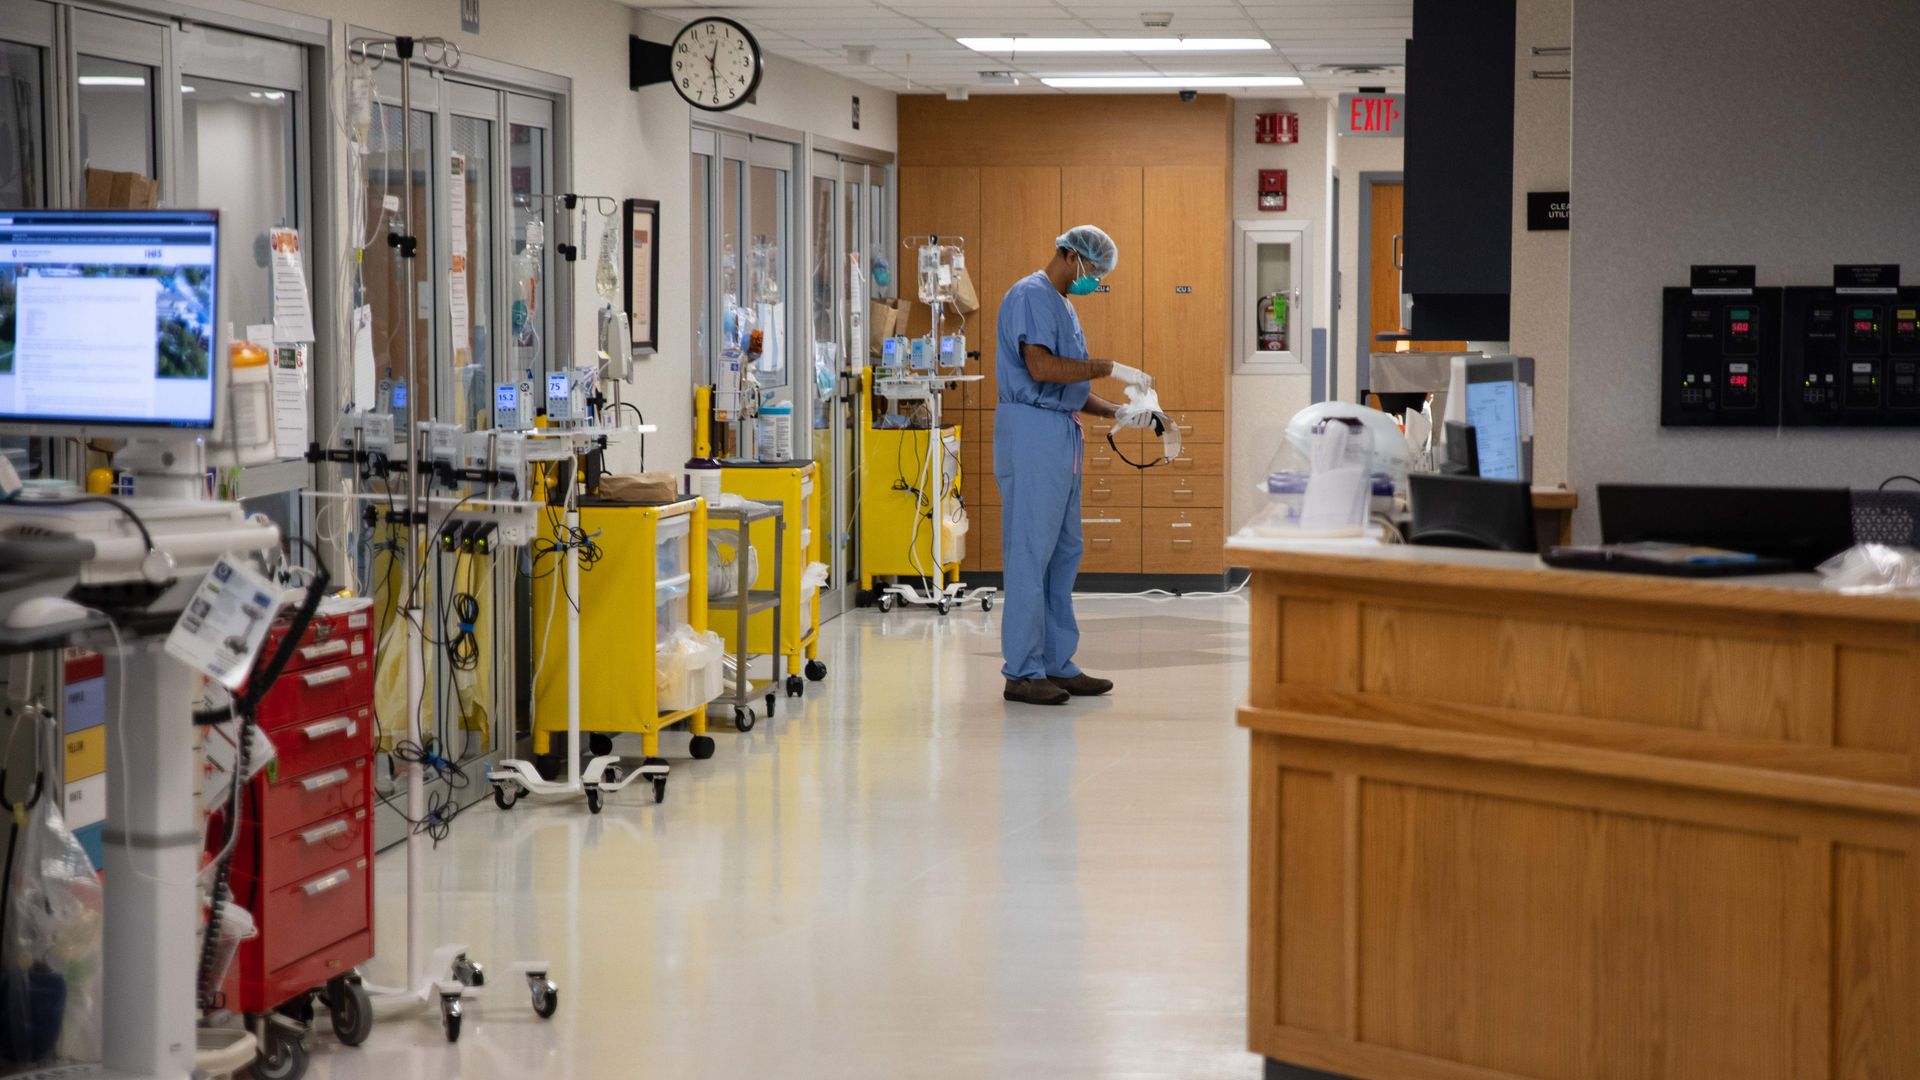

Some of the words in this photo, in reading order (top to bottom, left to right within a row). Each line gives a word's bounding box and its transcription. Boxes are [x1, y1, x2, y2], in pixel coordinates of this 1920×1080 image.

[706, 24, 715, 34] 12
[725, 27, 729, 38] 1
[691, 30, 698, 40] 11
[679, 43, 688, 53] 10
[737, 40, 744, 50] 2
[676, 61, 682, 71] 9
[743, 57, 749, 67] 3
[683, 78, 689, 88] 8
[738, 75, 744, 85] 4
[697, 91, 702, 101] 7
[729, 89, 735, 99] 5
[713, 95, 719, 104] 6
[1351, 98, 1395, 132] EXIT
[550, 383, 560, 391] 75
